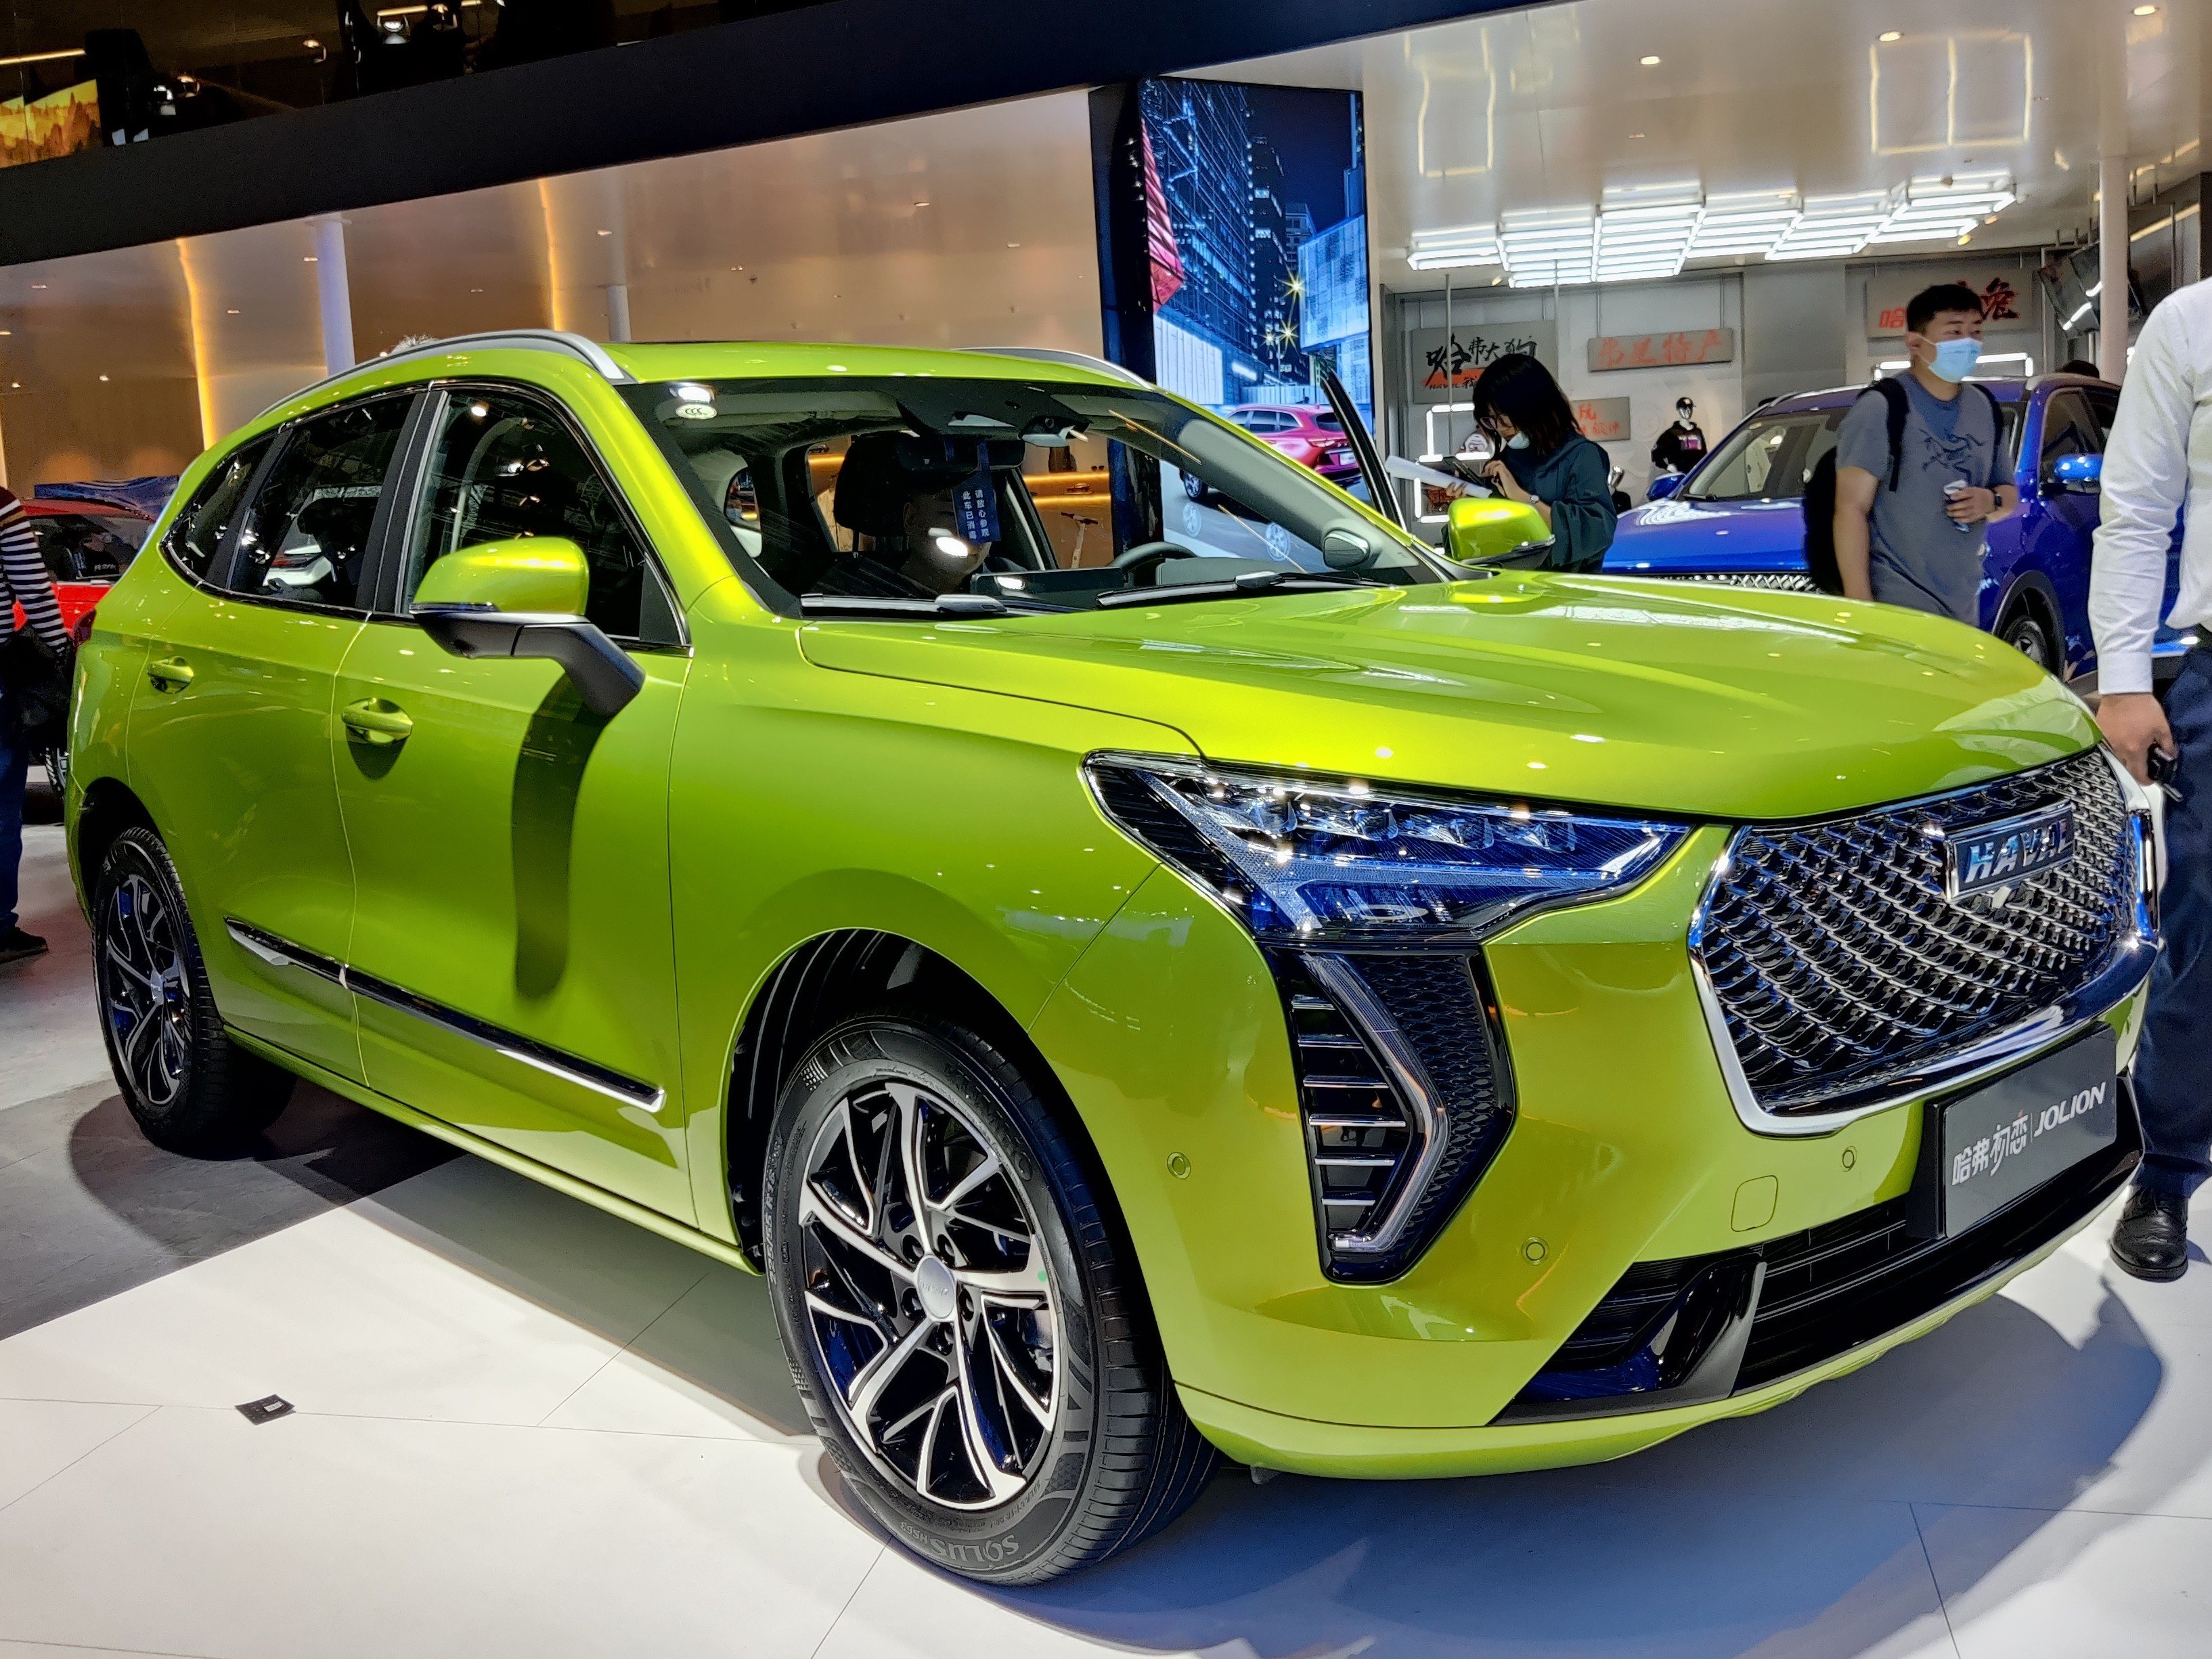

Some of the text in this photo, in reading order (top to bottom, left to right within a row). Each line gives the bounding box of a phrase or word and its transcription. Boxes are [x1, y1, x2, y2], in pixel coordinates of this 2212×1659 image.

[1964, 819, 2074, 883] HAVAL
[1952, 1082, 2107, 1185] 哈弗初恋 JOLION
[929, 1534, 1019, 1563] SOLUS
